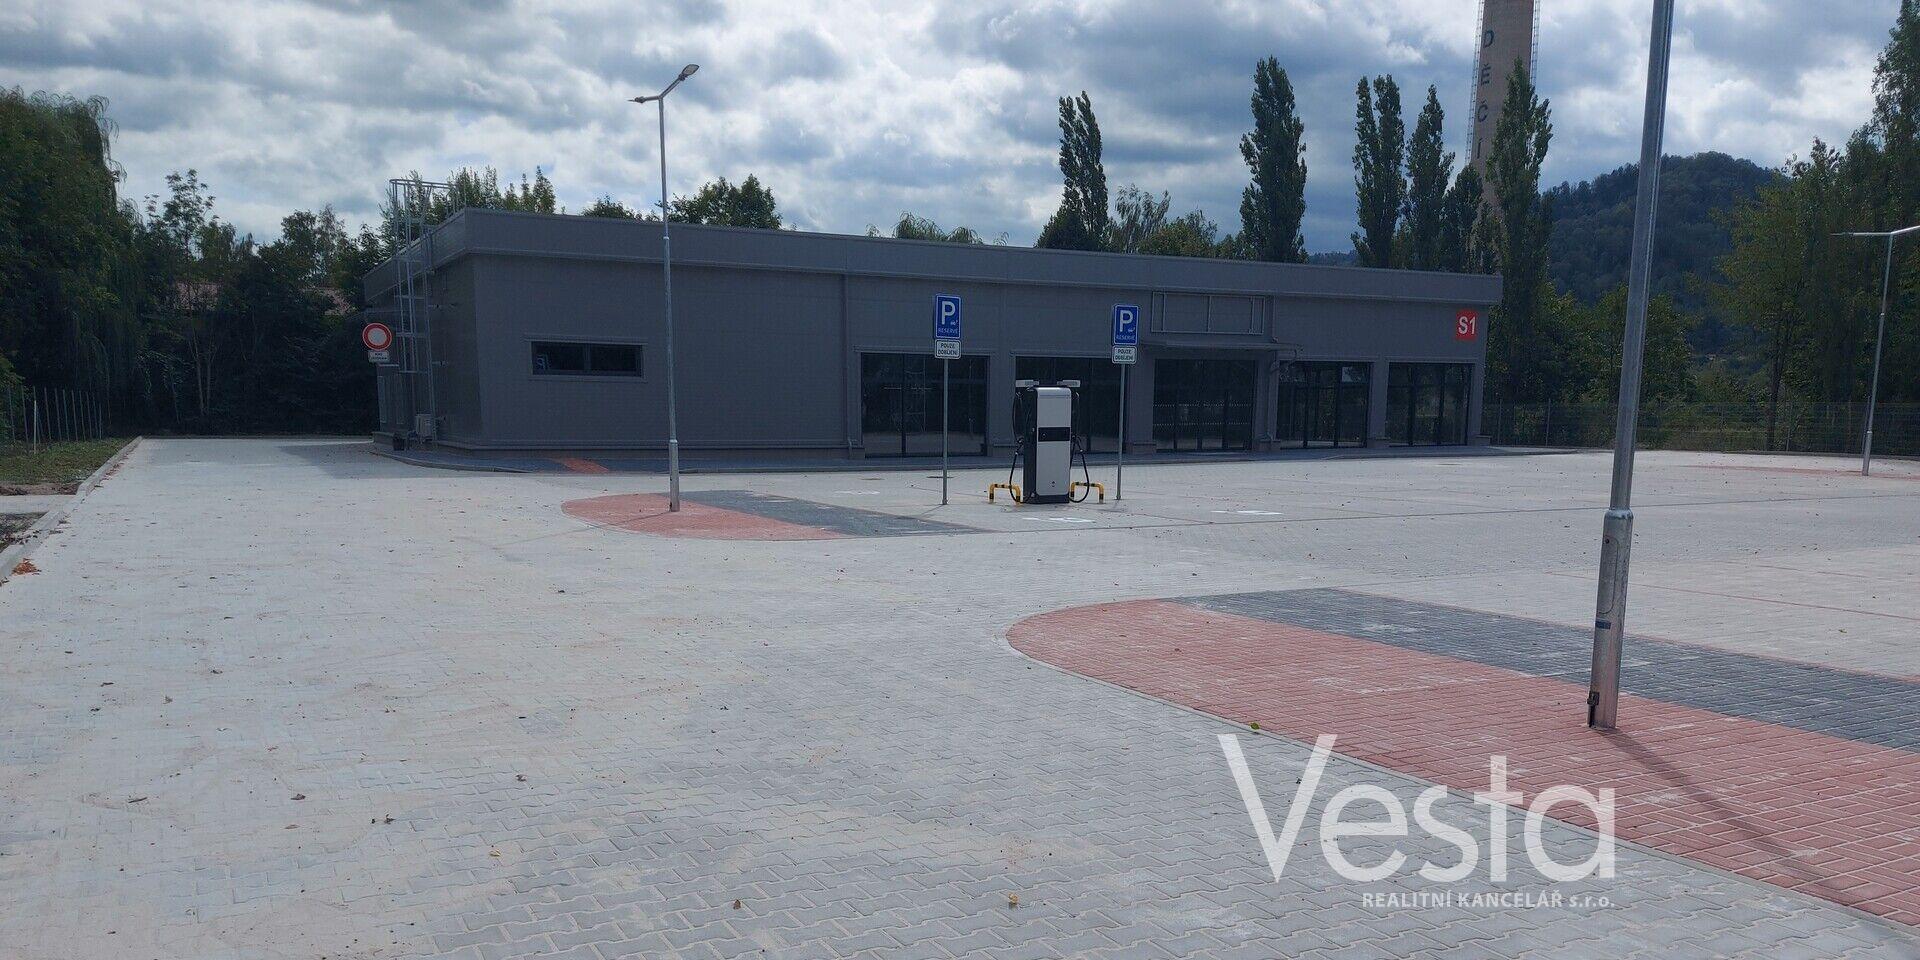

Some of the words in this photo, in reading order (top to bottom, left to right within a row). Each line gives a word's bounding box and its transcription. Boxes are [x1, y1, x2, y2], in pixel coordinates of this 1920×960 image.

[941, 300, 956, 325] P
[1120, 309, 1134, 332] P
[1458, 316, 1476, 335] S1
